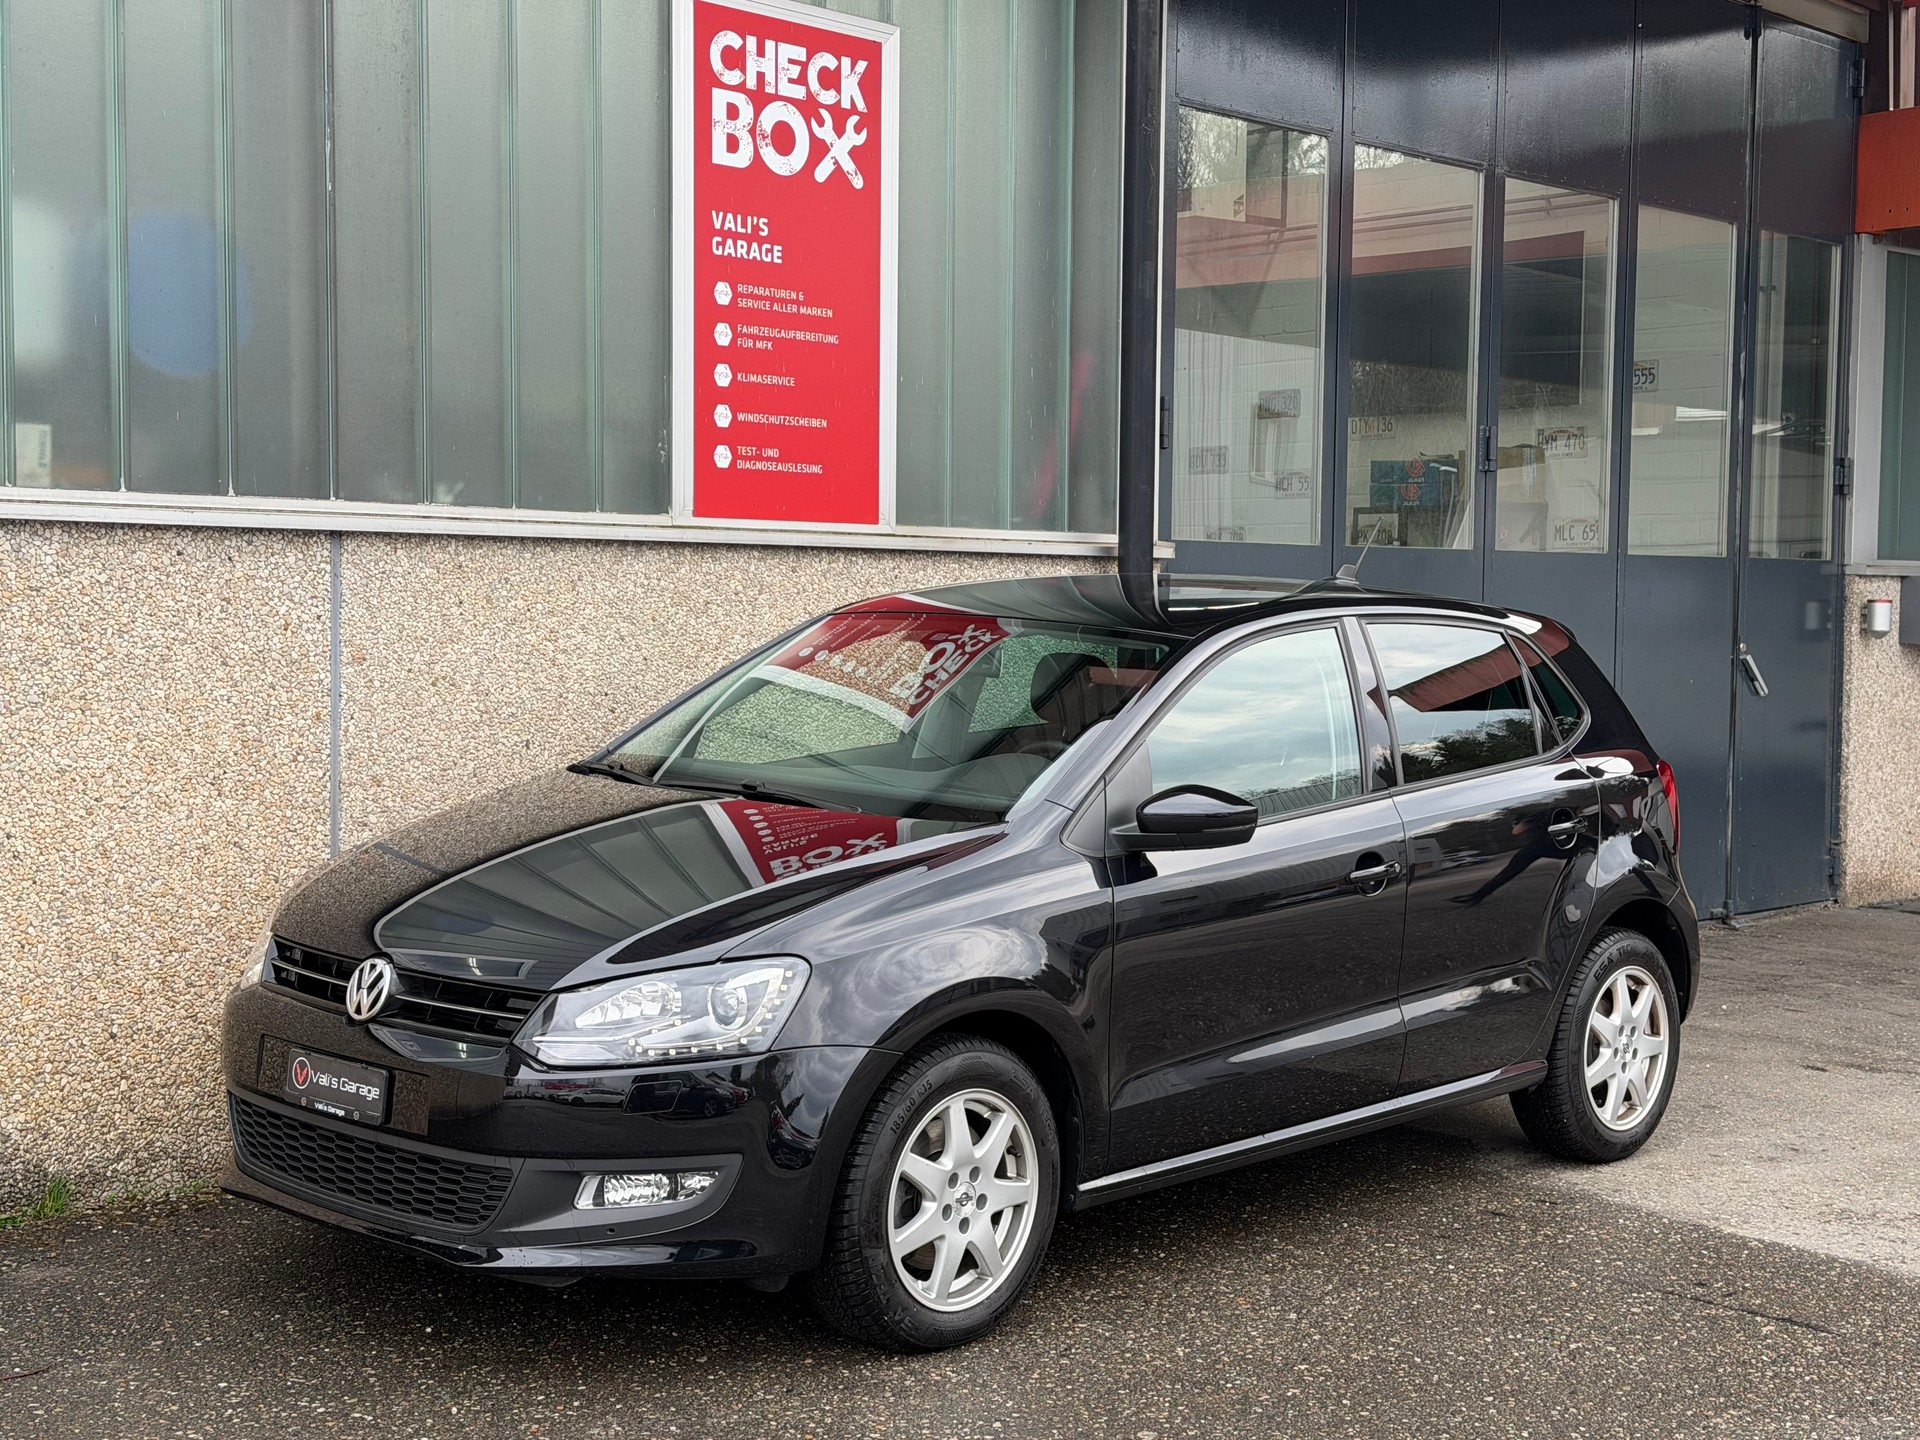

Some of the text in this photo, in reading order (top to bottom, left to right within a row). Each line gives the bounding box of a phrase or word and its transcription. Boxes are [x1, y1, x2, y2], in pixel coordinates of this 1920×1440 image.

[709, 30, 868, 113] CHECK
[711, 87, 868, 189] BOX
[711, 210, 769, 236] VALI'S
[712, 236, 782, 263] GARAGE
[737, 284, 804, 301] REPARATUREN &
[737, 298, 833, 318] SERVICE ALLER MARKEN
[737, 324, 839, 345] FAHRZEUGAUFBEREITUNG
[737, 337, 773, 351] FÜR MFK
[737, 372, 796, 387] KLIMASERVICE
[1634, 366, 1656, 386] 555
[1281, 395, 1298, 411] 320
[737, 411, 827, 428] WINDSCHUTZSCHEIBEN
[1377, 417, 1393, 433] 136
[1564, 433, 1585, 451] 470
[737, 445, 779, 458] TEST- UND
[737, 459, 823, 474] DIAGNOSEAUSLESUNG
[1298, 475, 1312, 492] 55
[1554, 525, 1575, 542] MLC
[339, 1077, 380, 1101] Garage
[327, 1104, 345, 1117] Garage
[889, 1097, 916, 1135] 185/60
